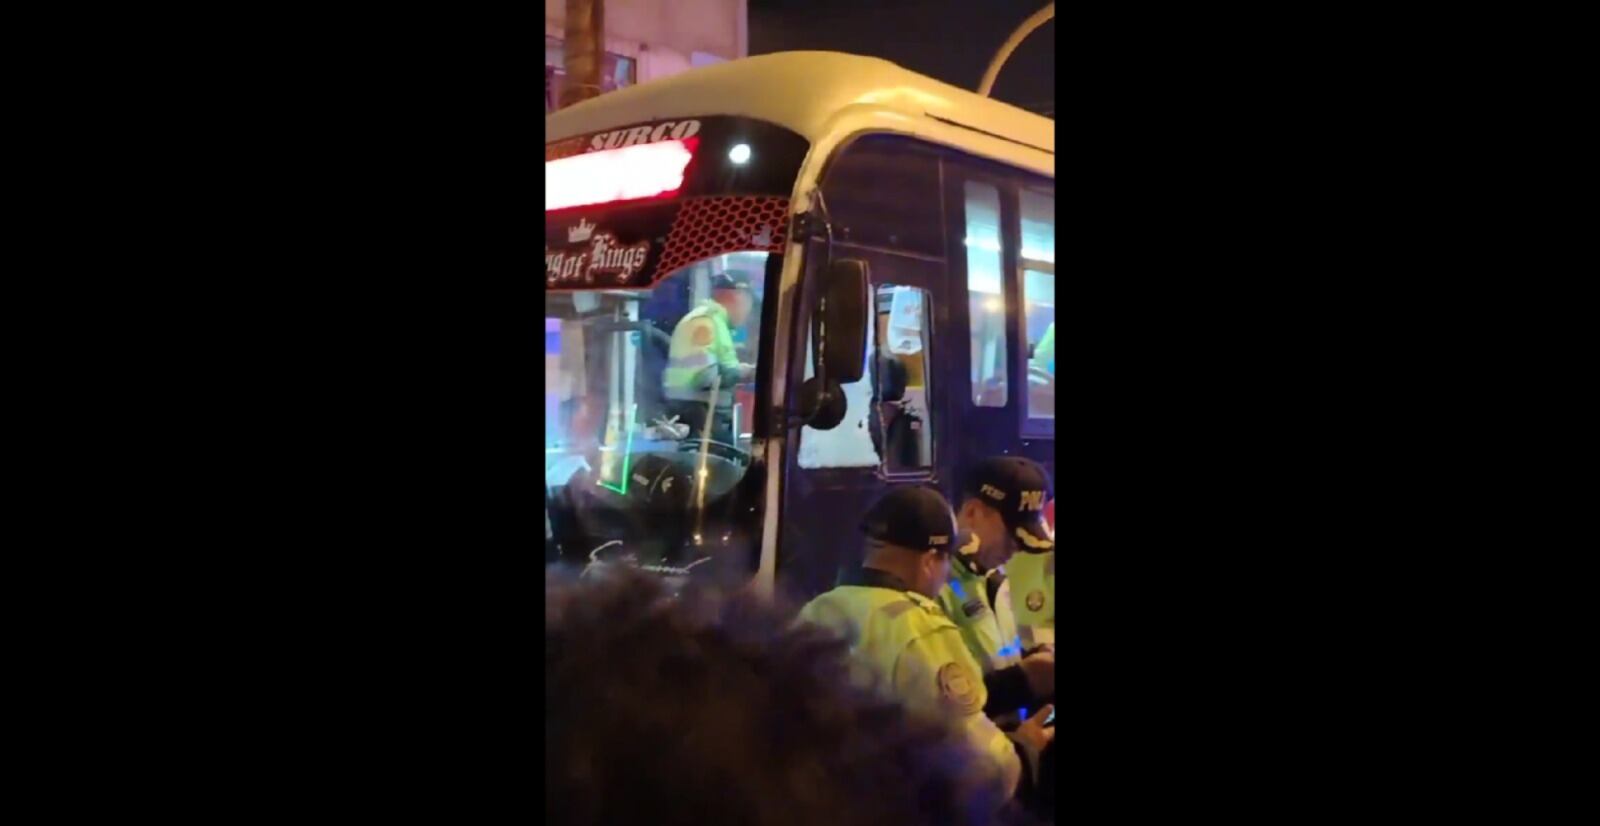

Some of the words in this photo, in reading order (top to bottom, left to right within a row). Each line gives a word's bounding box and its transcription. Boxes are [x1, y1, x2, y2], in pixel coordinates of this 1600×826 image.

[588, 119, 700, 152] SURCO
[562, 253, 587, 278] of
[586, 234, 647, 282] Kings
